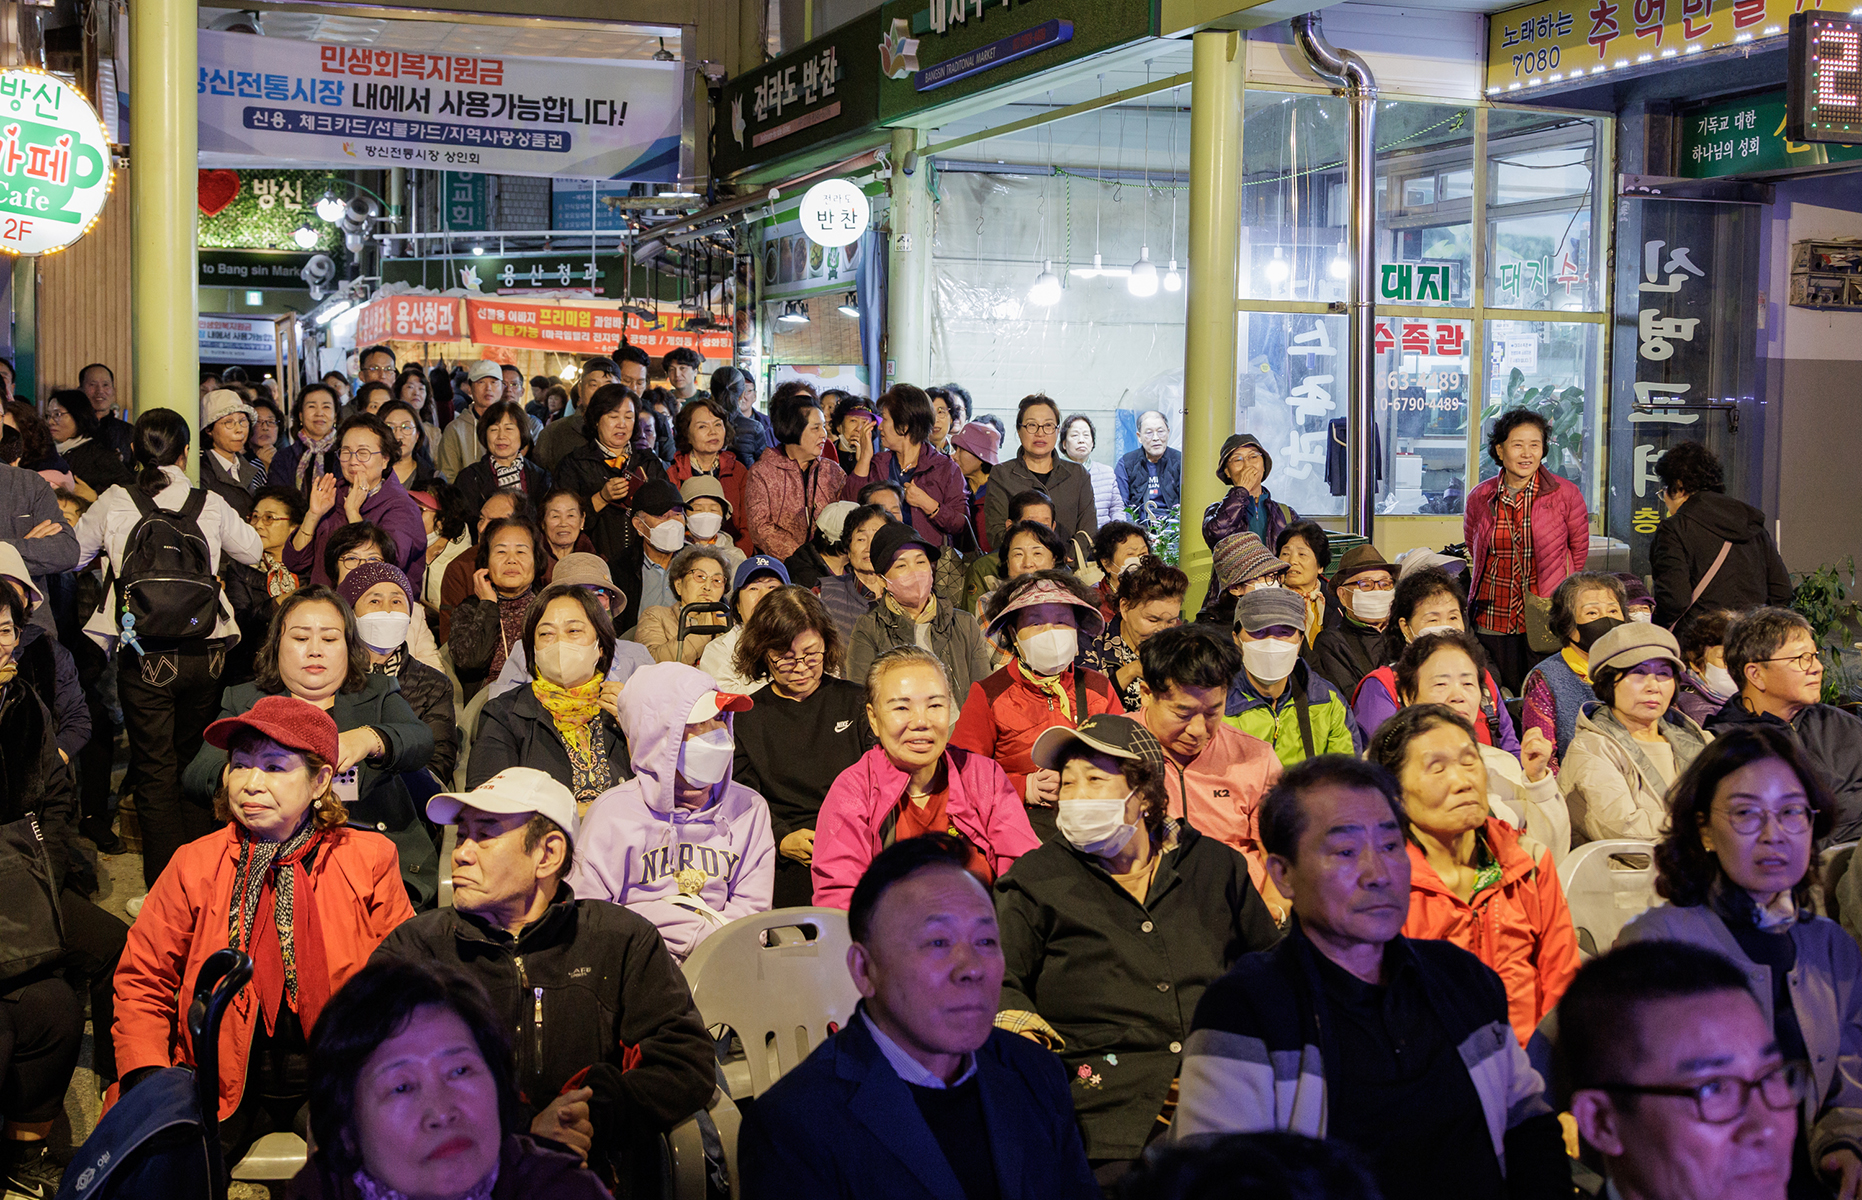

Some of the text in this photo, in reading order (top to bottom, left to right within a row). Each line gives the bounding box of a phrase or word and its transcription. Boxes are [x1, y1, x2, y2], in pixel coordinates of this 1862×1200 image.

[1501, 10, 1574, 49] 노래하는
[320, 46, 504, 86] 민생회복지원금
[976, 46, 997, 64] MARKET
[1512, 46, 1562, 77] 7080
[1, 75, 61, 121] 방신
[754, 46, 838, 122] 전라도 반찬
[352, 83, 430, 114] 내에서
[438, 90, 628, 127] 사용가능합니다!
[253, 111, 292, 129] 신용,
[1698, 115, 1729, 136] 기독교
[1734, 109, 1757, 131] 대한
[365, 145, 480, 164] 방신전통시장 상인회
[1692, 136, 1760, 164] 하나님의 성회
[253, 179, 302, 209] 방신
[3, 219, 33, 241] 2F
[817, 208, 858, 230] 반찬
[203, 263, 215, 274] to
[218, 263, 248, 277] Bang
[251, 265, 269, 276] sin
[502, 263, 598, 287] 용산청과
[1381, 263, 1451, 303] 대지
[396, 301, 454, 336] 용산청과
[540, 309, 591, 328] 프리미엄
[492, 323, 539, 338] 배달가능
[593, 331, 620, 343] 전지역
[1375, 322, 1464, 356] 수족관
[1213, 789, 1231, 798] K2
[638, 842, 740, 885] NERDY
